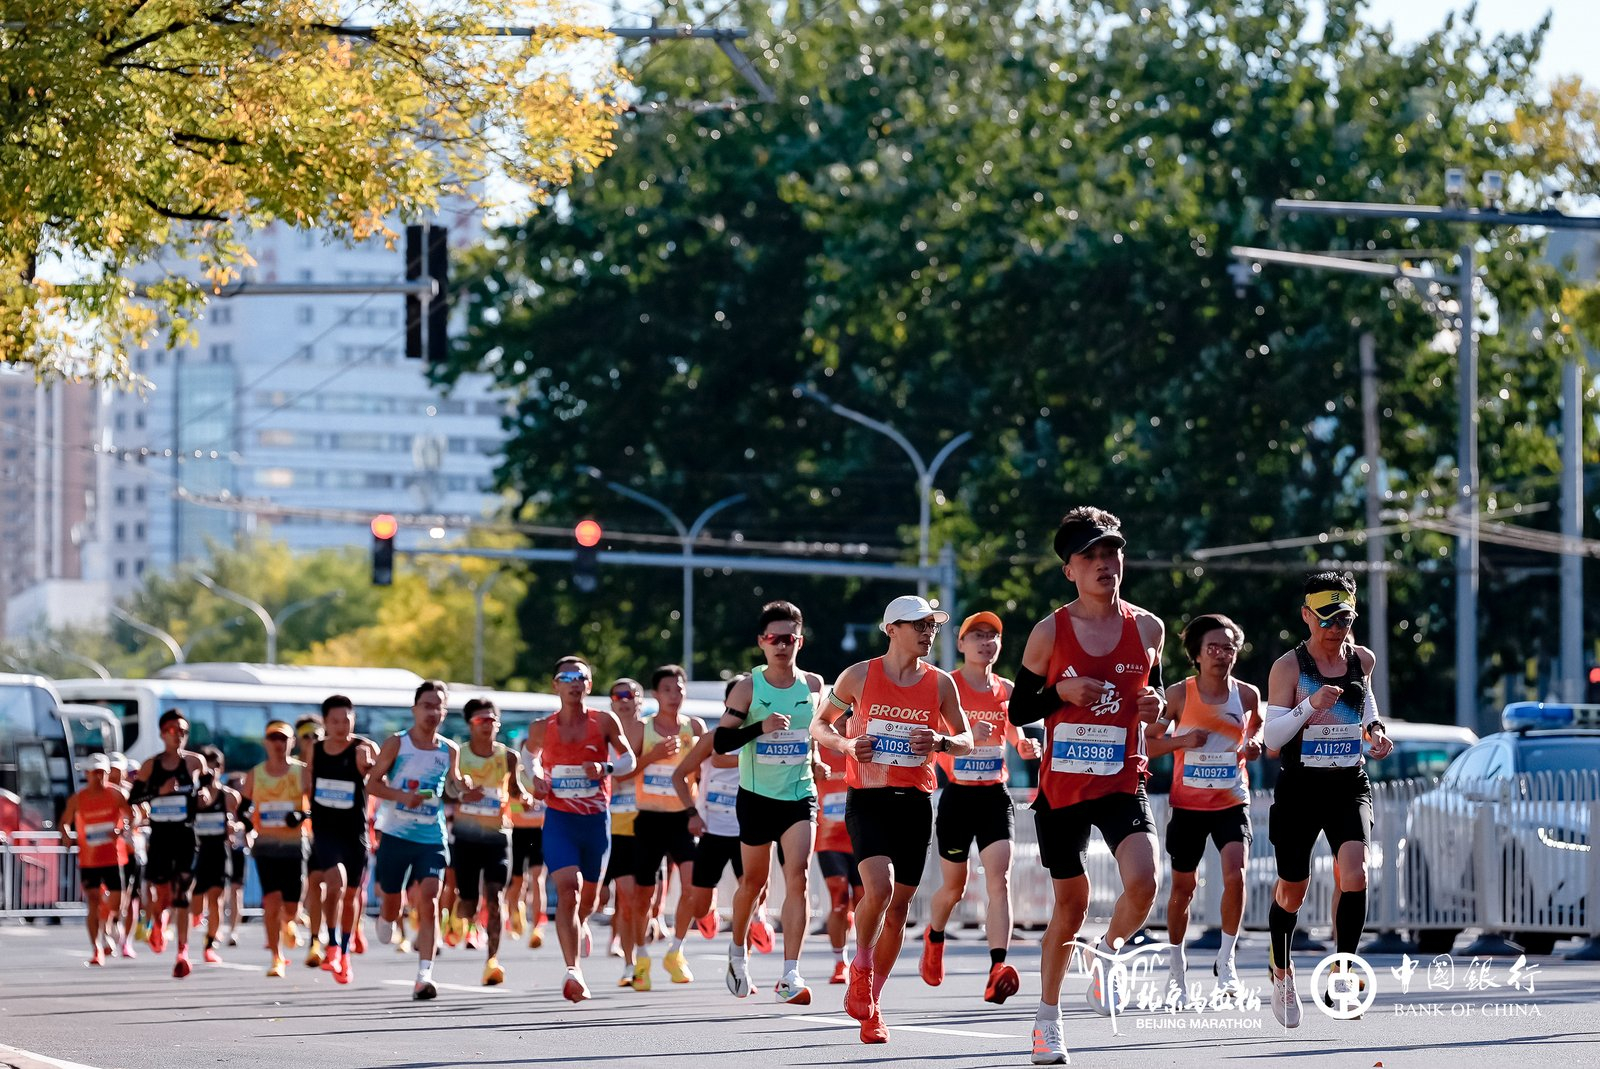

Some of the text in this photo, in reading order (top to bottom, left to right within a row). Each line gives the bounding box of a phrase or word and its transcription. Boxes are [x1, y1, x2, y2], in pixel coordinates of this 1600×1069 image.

[868, 704, 931, 722] BROOKS
[765, 744, 800, 754] A13974
[875, 738, 915, 754] A1093
[1066, 744, 1114, 760] A13988
[1314, 742, 1352, 754] A11278
[1192, 767, 1228, 778] A10973
